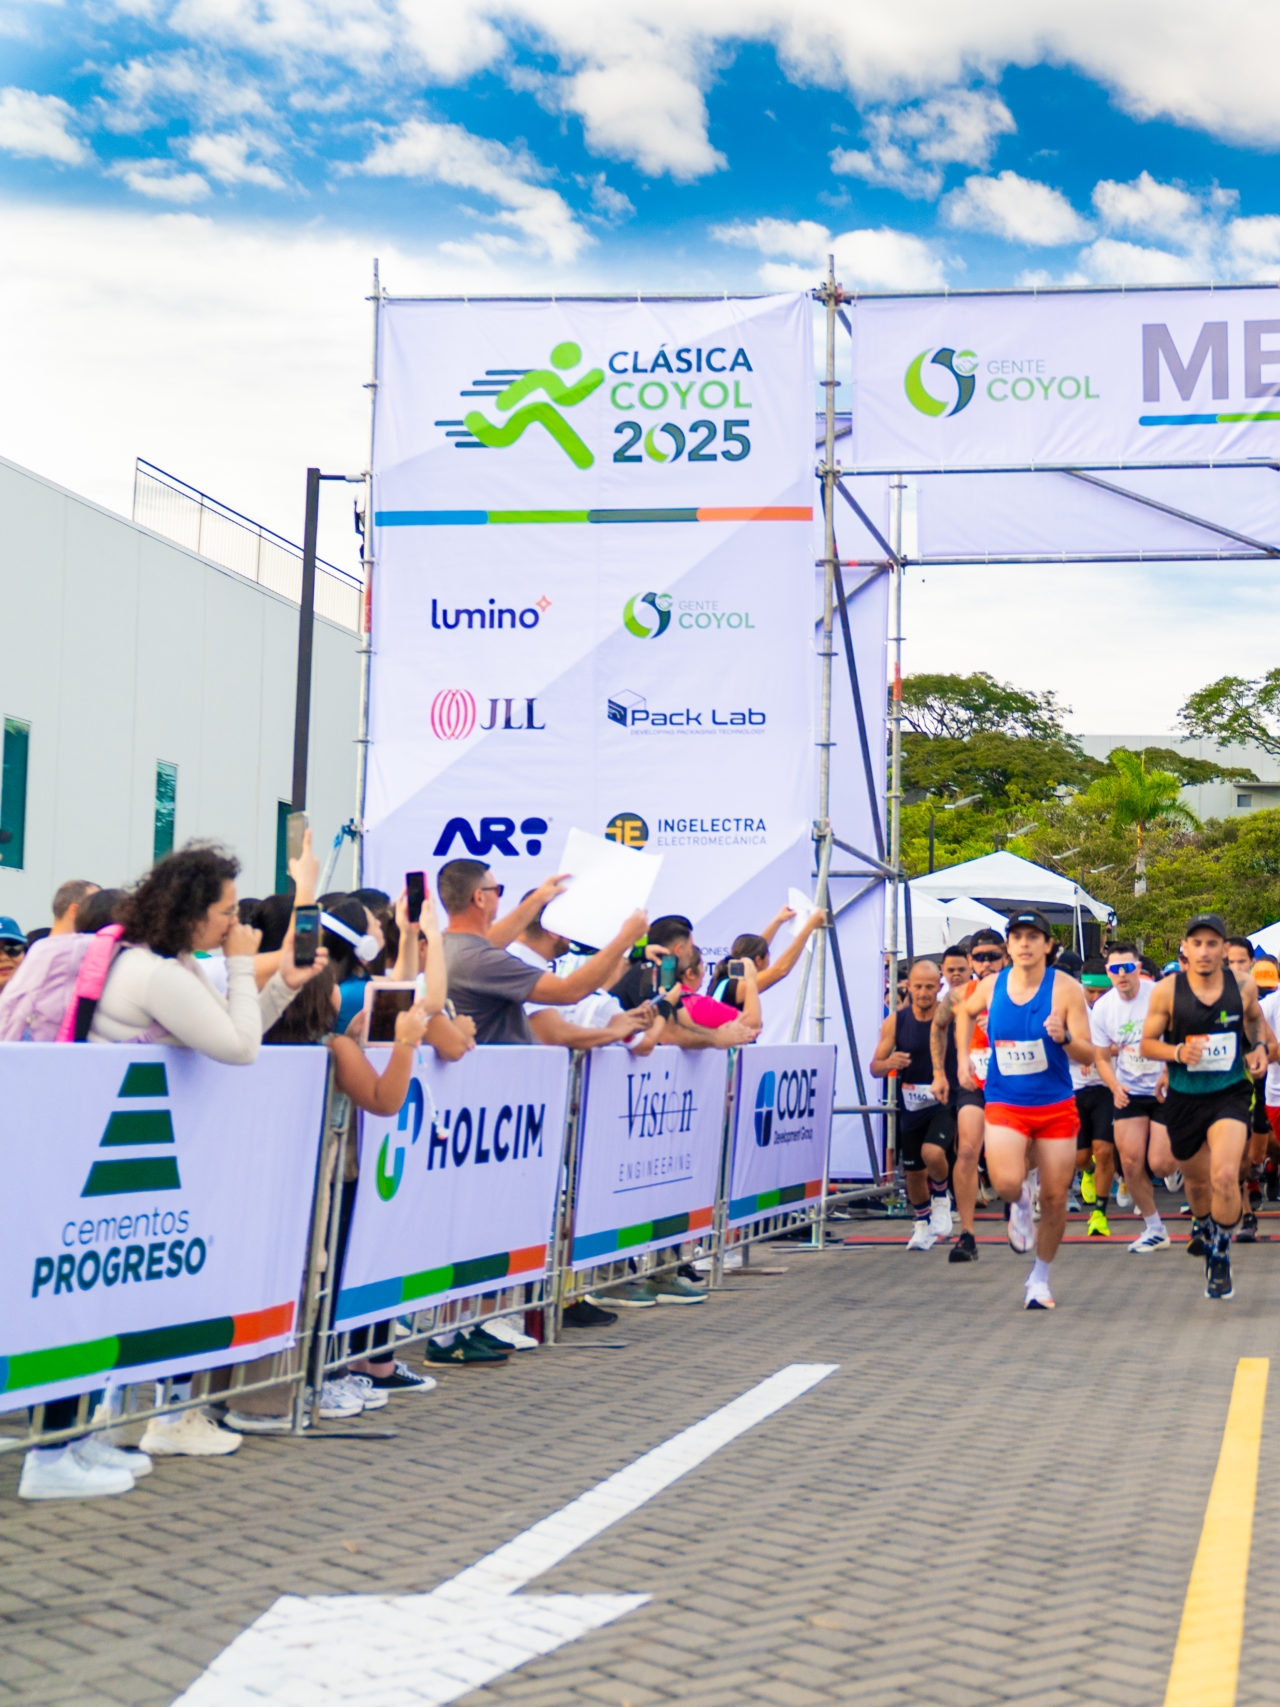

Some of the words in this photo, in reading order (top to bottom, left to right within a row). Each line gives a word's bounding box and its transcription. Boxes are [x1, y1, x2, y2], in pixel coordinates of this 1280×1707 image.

[608, 343, 753, 374] CLÁSICA
[987, 360, 1045, 375] GENTE
[610, 380, 752, 411] COYOL
[987, 376, 1099, 402] COYOL
[613, 419, 751, 464] 2025
[431, 598, 540, 630] lumino
[678, 600, 719, 611] GENTE
[678, 612, 755, 630] COYOL
[480, 697, 546, 730] JLL
[631, 708, 702, 726] Pack
[712, 708, 766, 726] Lab
[657, 834, 767, 847] ELECTROMECÁNICA
[658, 818, 767, 832] INGELECTRA
[1008, 1050, 1035, 1061] 1313
[777, 1069, 818, 1121] CODE
[427, 1103, 546, 1171] HOLCIM
[61, 1206, 190, 1248] cementos
[31, 1236, 207, 1299] PROGRESO
